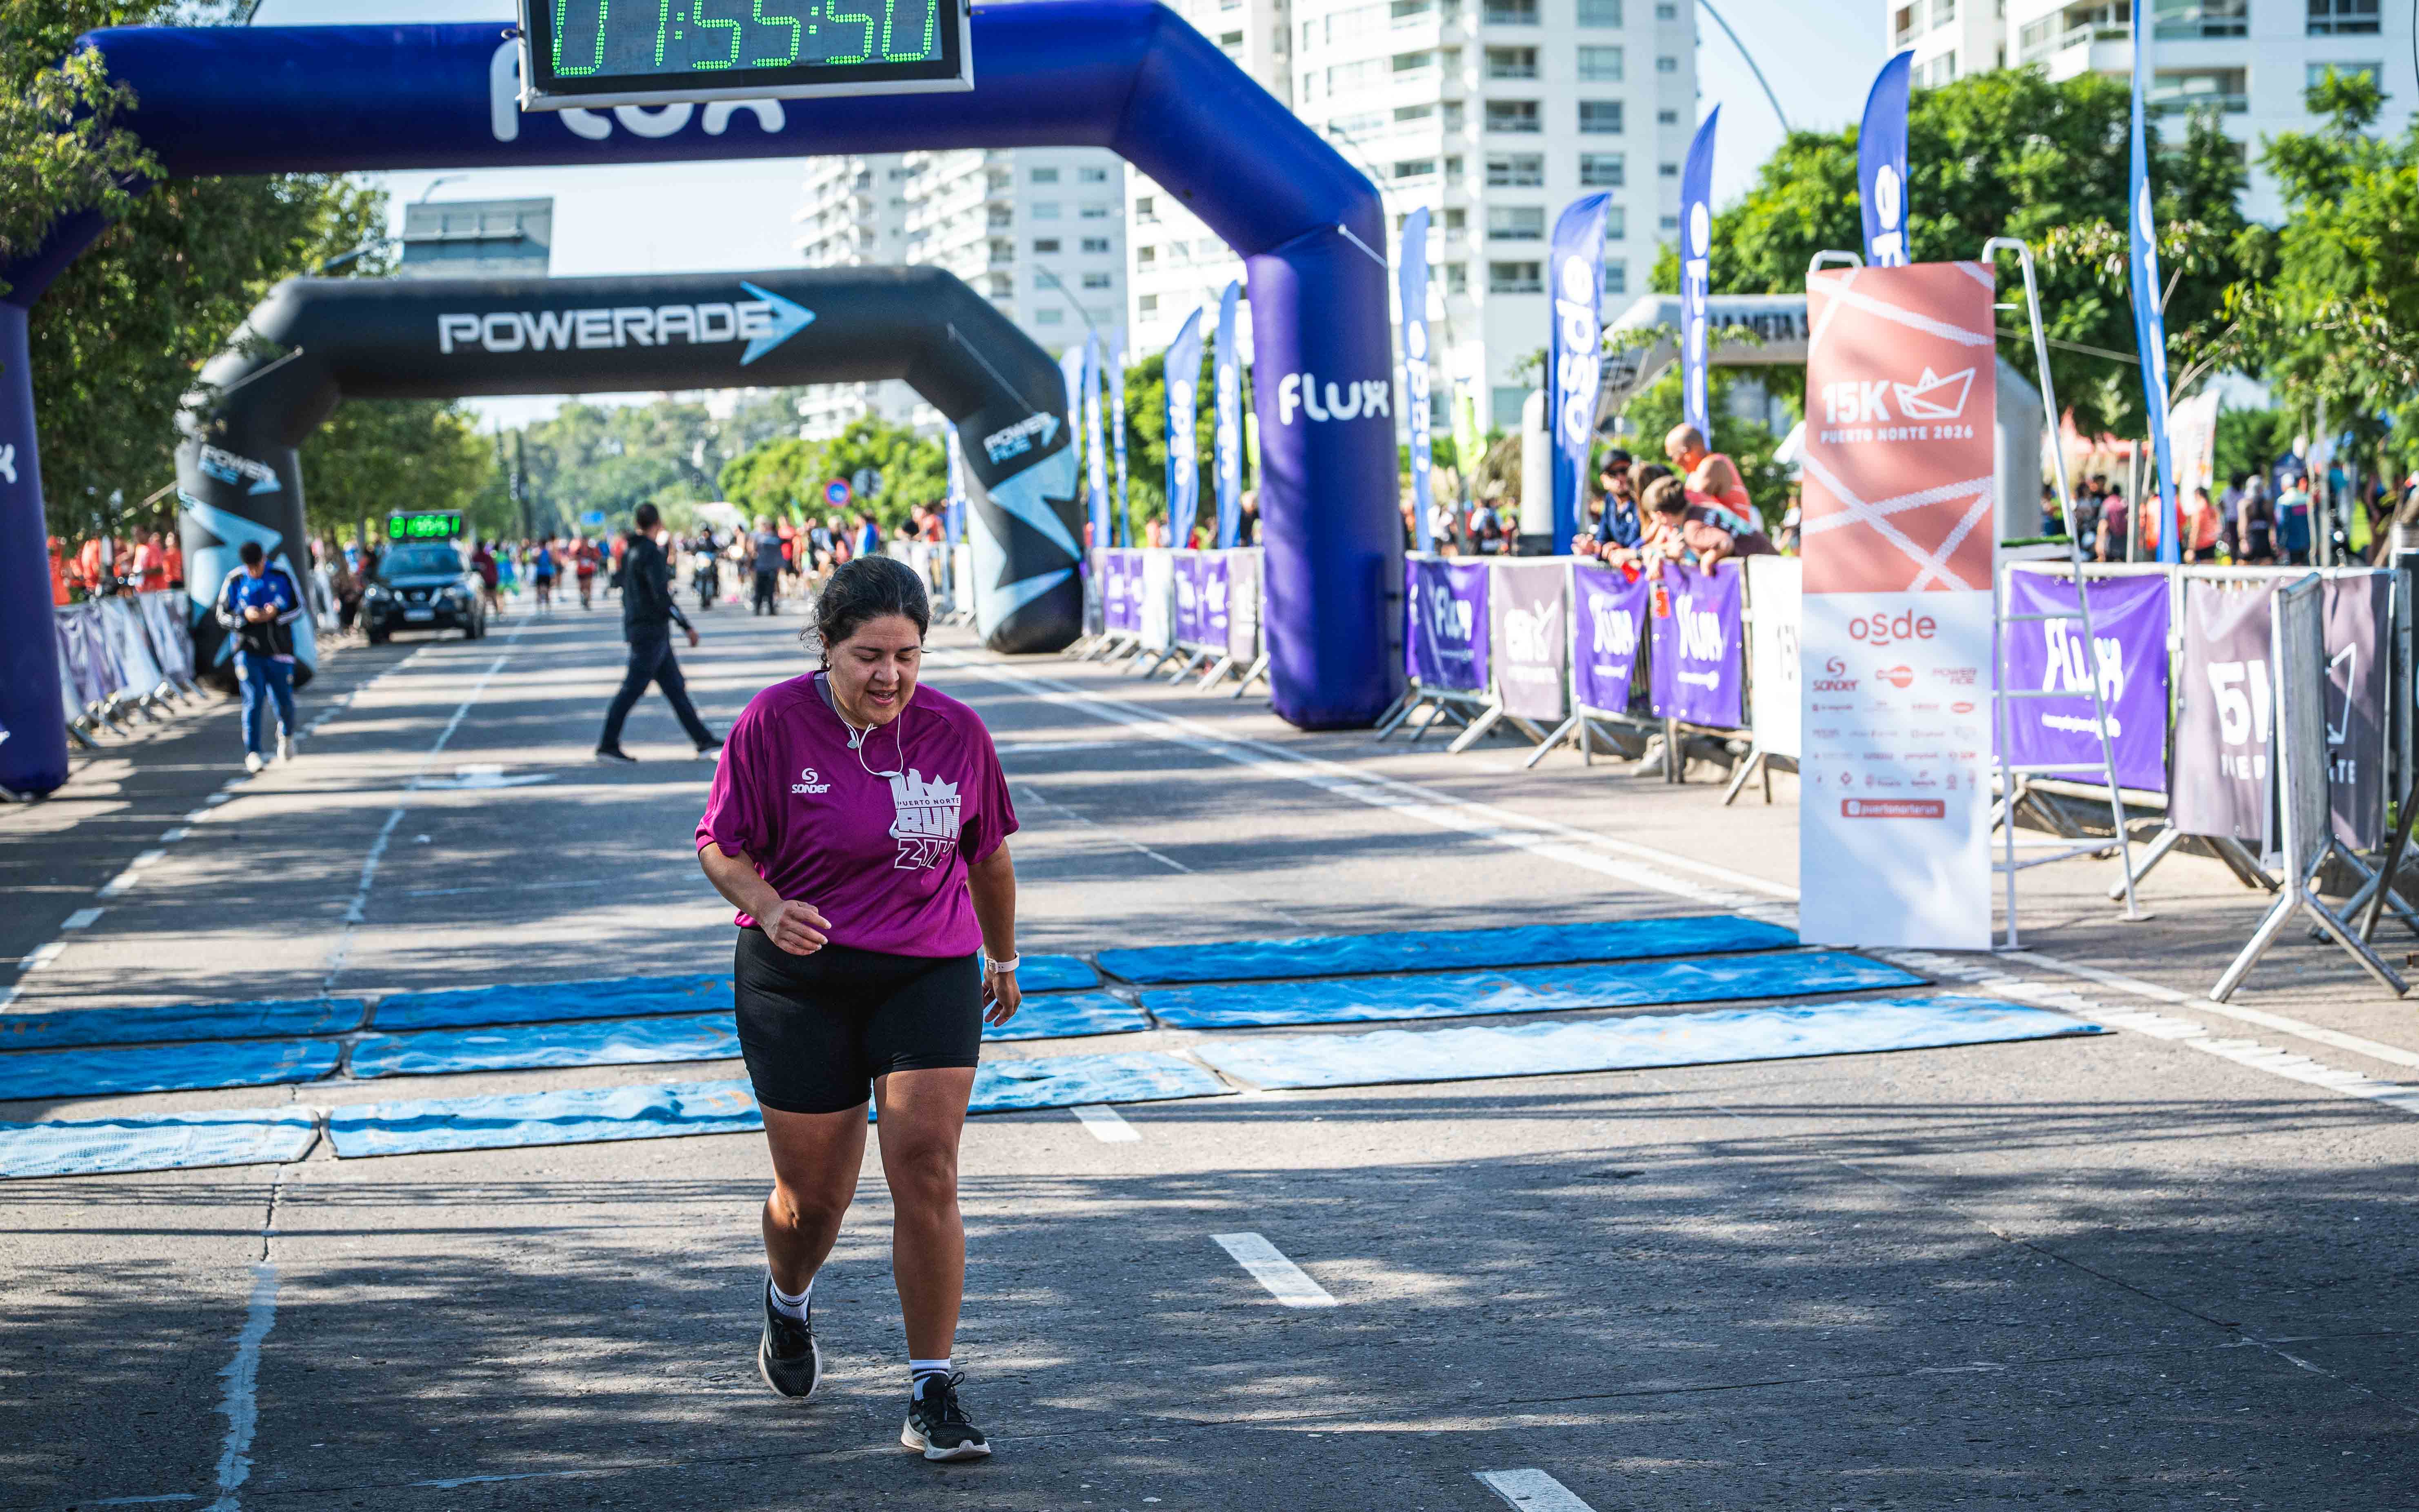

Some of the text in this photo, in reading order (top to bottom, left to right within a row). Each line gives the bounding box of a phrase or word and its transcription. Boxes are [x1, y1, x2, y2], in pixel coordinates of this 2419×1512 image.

[438, 300, 774, 354] POWERADE
[1279, 372, 1389, 426] FLUX
[1821, 380, 1891, 424] 15K
[1820, 424, 1974, 444] PUERTO NORTE 2026
[1849, 608, 1937, 640] osde
[897, 806, 960, 839] RUN
[894, 838, 955, 870] 21K
